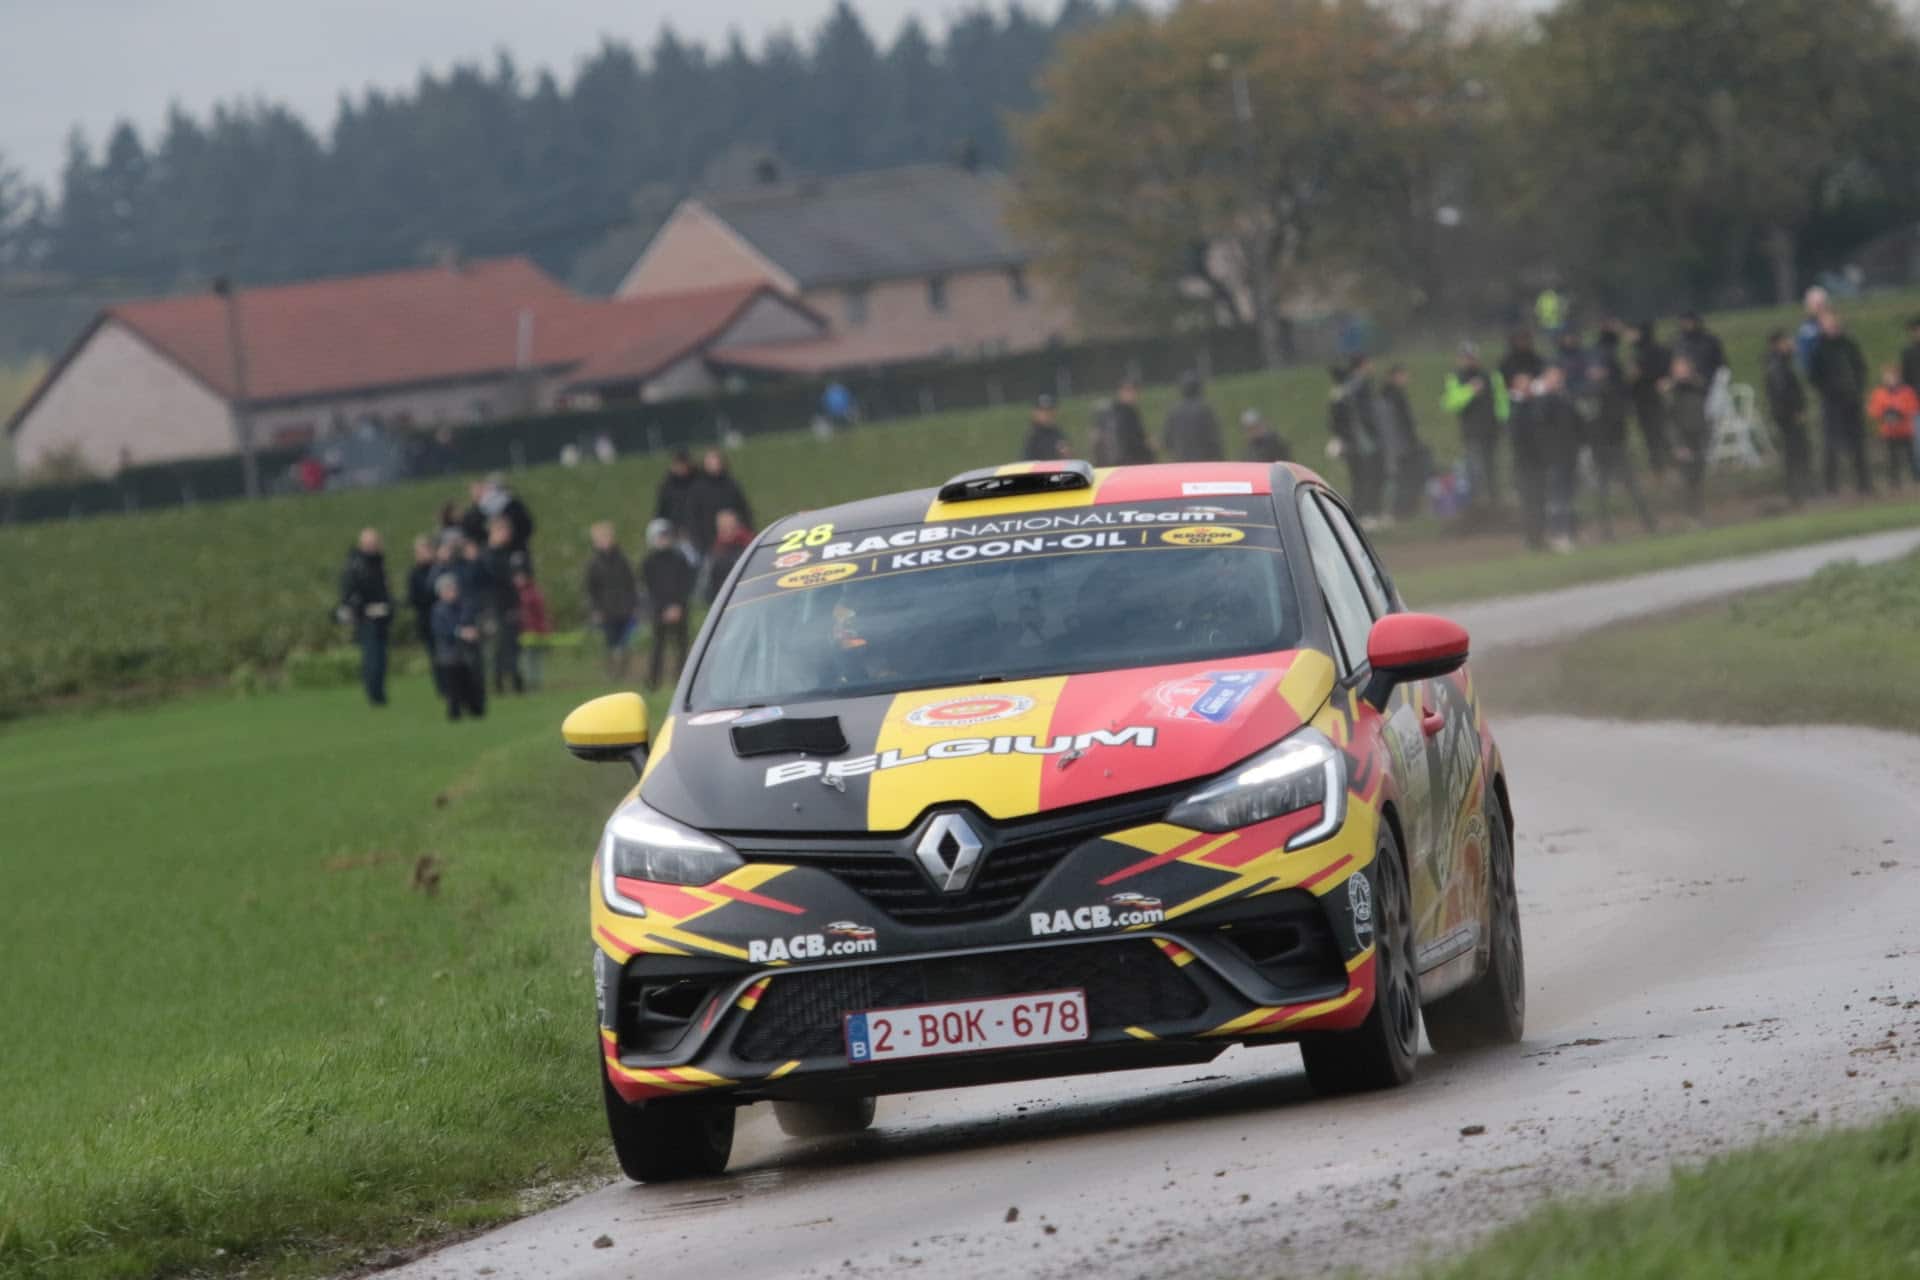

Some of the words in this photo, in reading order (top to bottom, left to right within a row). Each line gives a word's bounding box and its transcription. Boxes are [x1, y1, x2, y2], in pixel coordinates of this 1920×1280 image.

[776, 524, 834, 553] 28
[891, 531, 1127, 569] KROON-OIL
[764, 727, 1157, 788] BELGIUM
[1029, 905, 1164, 936] RACB.com
[748, 934, 877, 963] RACB.com
[852, 1041, 866, 1058] B
